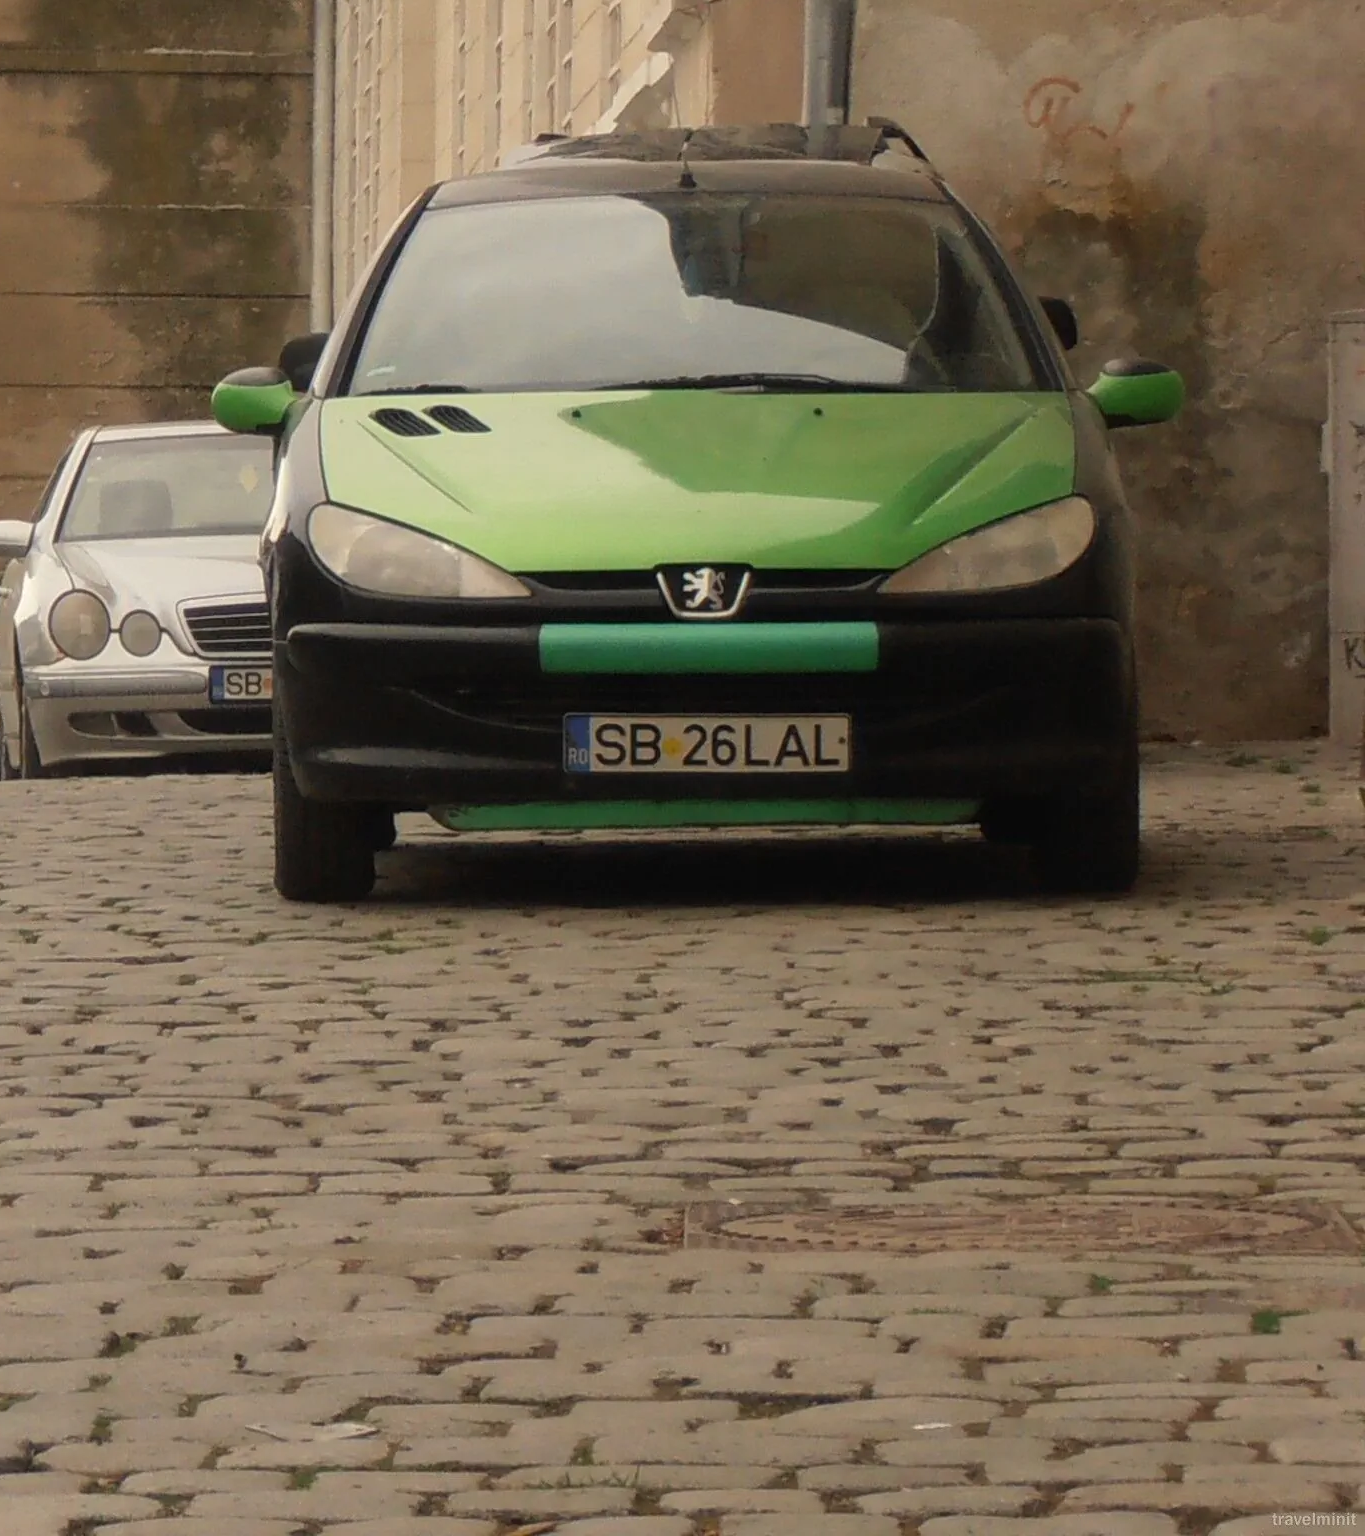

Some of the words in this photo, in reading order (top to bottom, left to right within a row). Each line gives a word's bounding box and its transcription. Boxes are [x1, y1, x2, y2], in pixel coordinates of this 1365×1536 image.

[226, 672, 262, 695] SB
[569, 747, 589, 765] RO
[595, 723, 662, 766] SB
